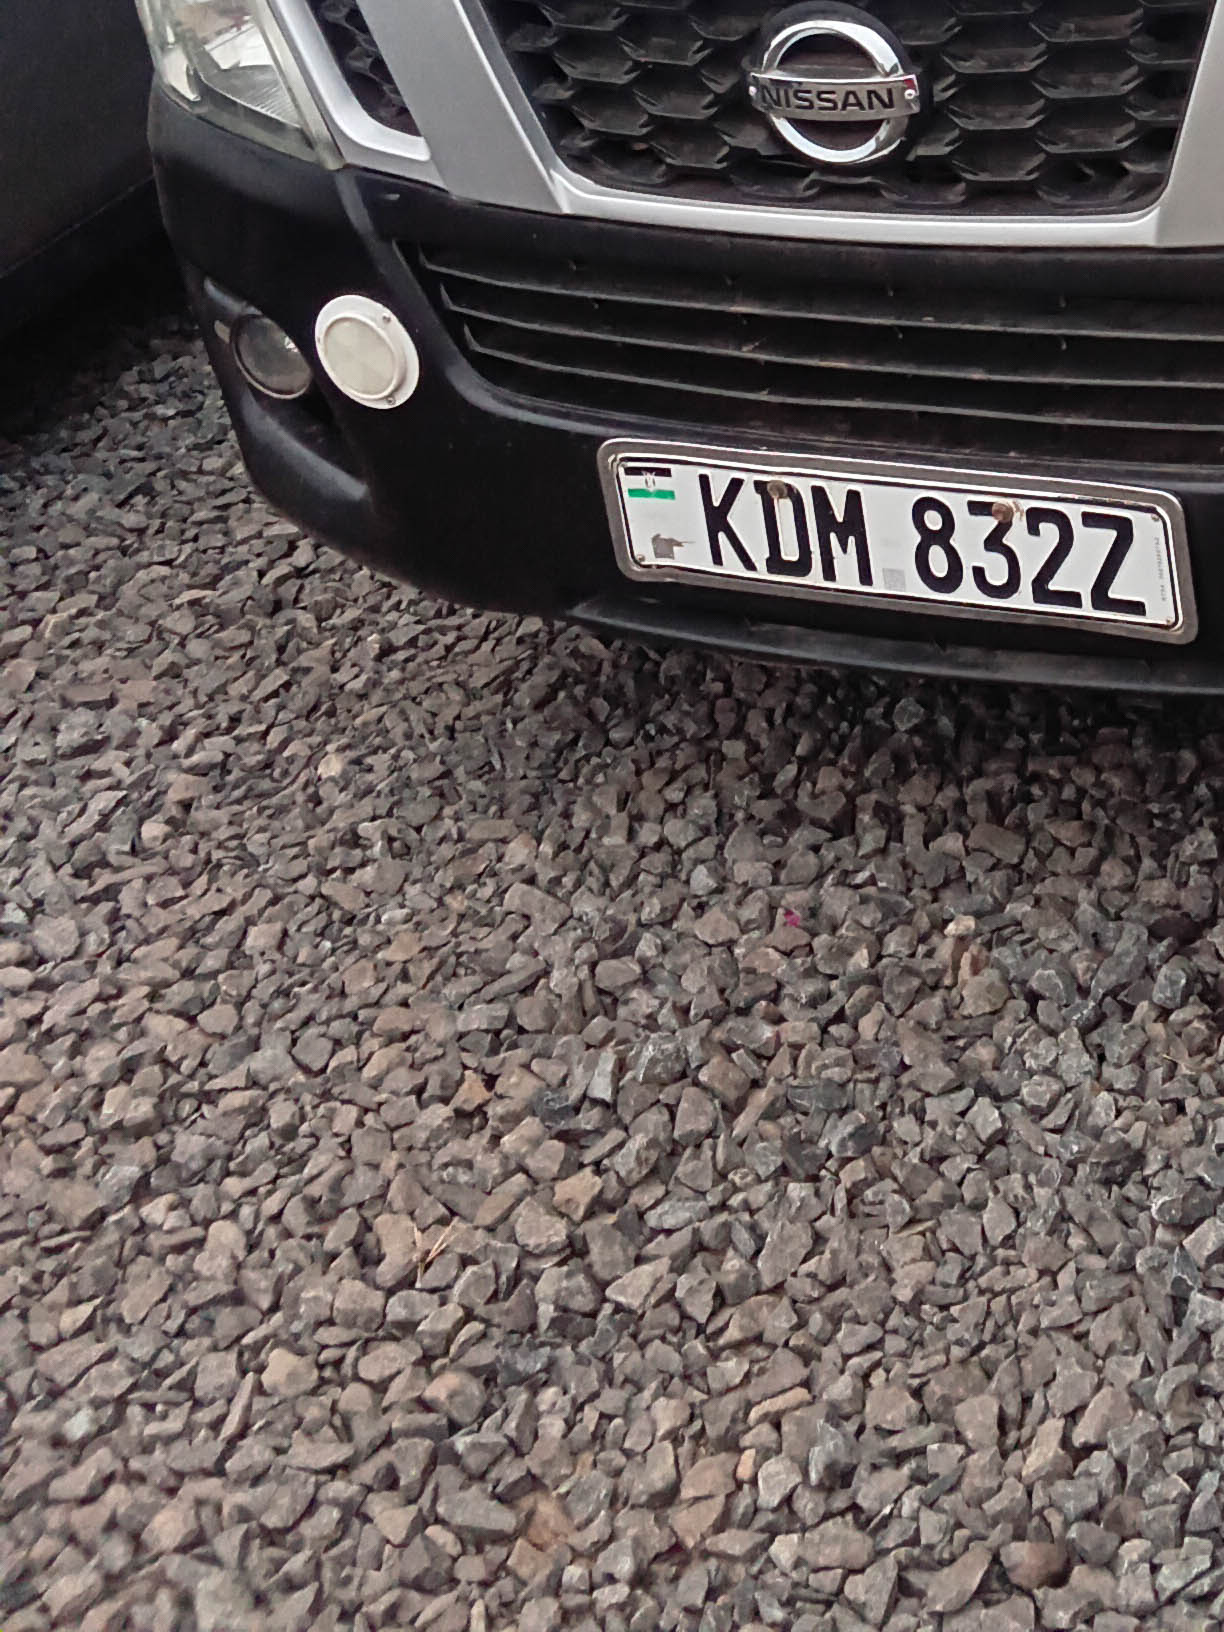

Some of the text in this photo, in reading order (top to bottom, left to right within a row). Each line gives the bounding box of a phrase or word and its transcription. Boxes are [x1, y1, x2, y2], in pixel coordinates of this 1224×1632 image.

[760, 85, 895, 113] NISSAN
[698, 472, 875, 587] KDM
[910, 496, 1148, 616] 832Z
